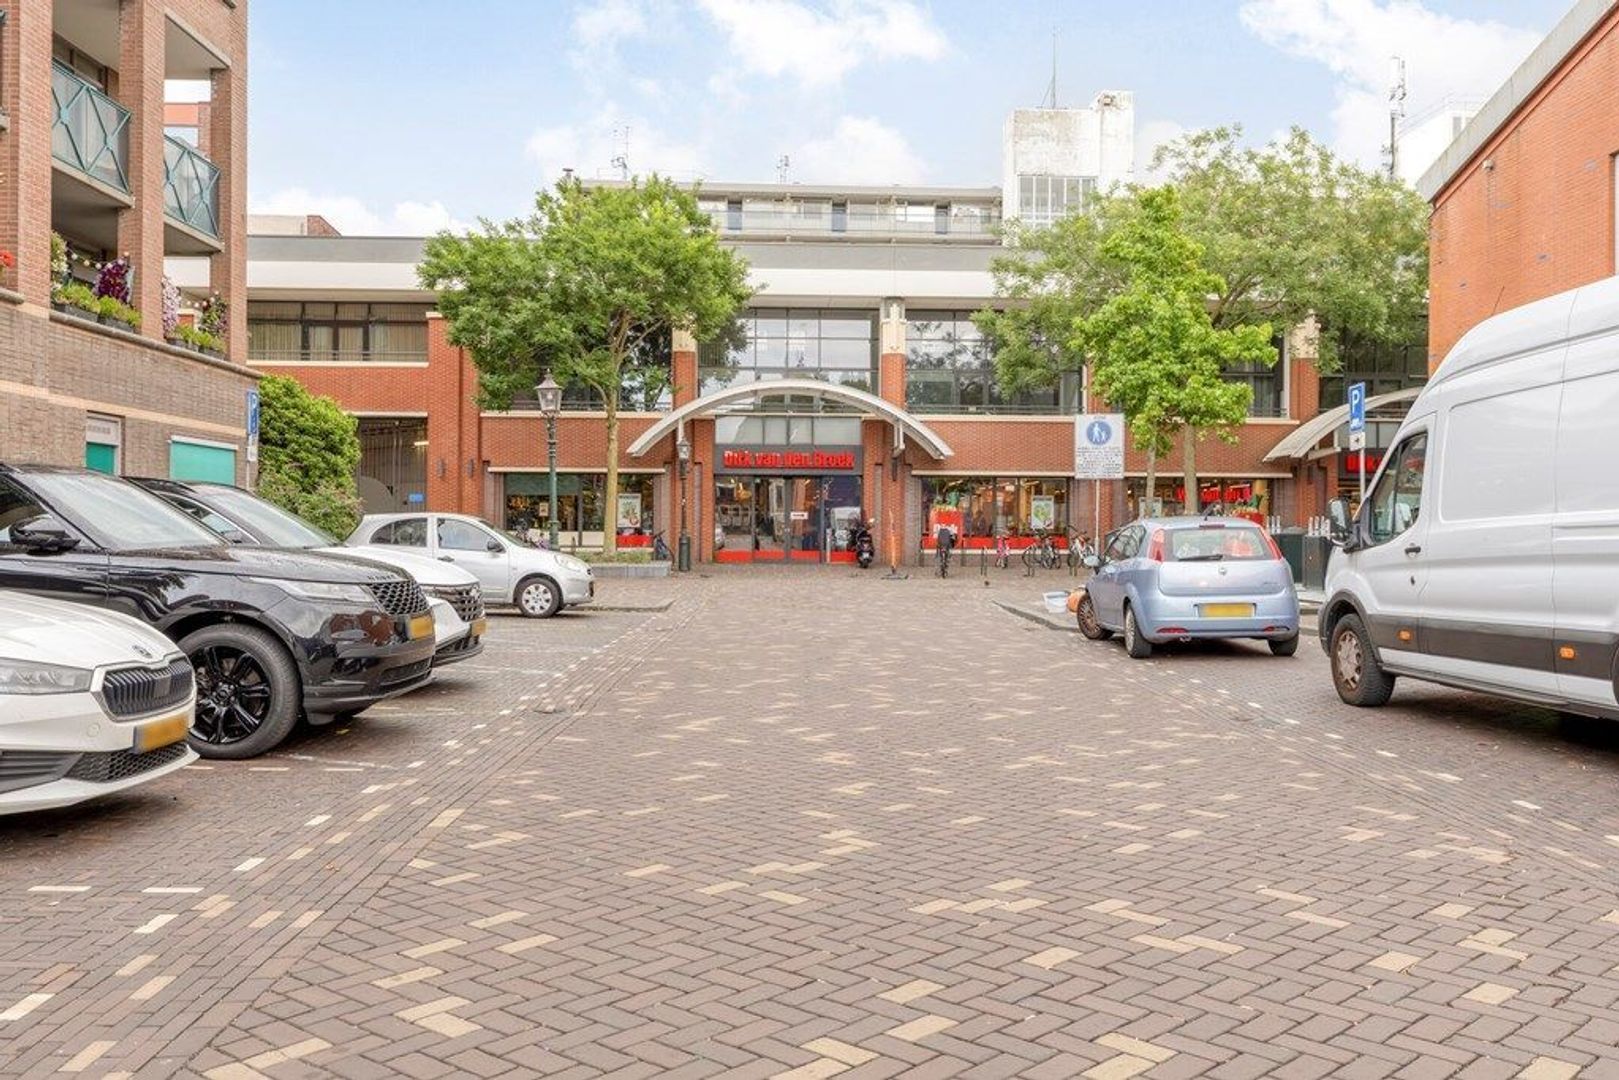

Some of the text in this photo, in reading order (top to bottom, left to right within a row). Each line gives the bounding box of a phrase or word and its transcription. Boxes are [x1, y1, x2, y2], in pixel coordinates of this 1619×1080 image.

[1352, 390, 1360, 413] P
[724, 451, 854, 468] Dirk van den Broek
